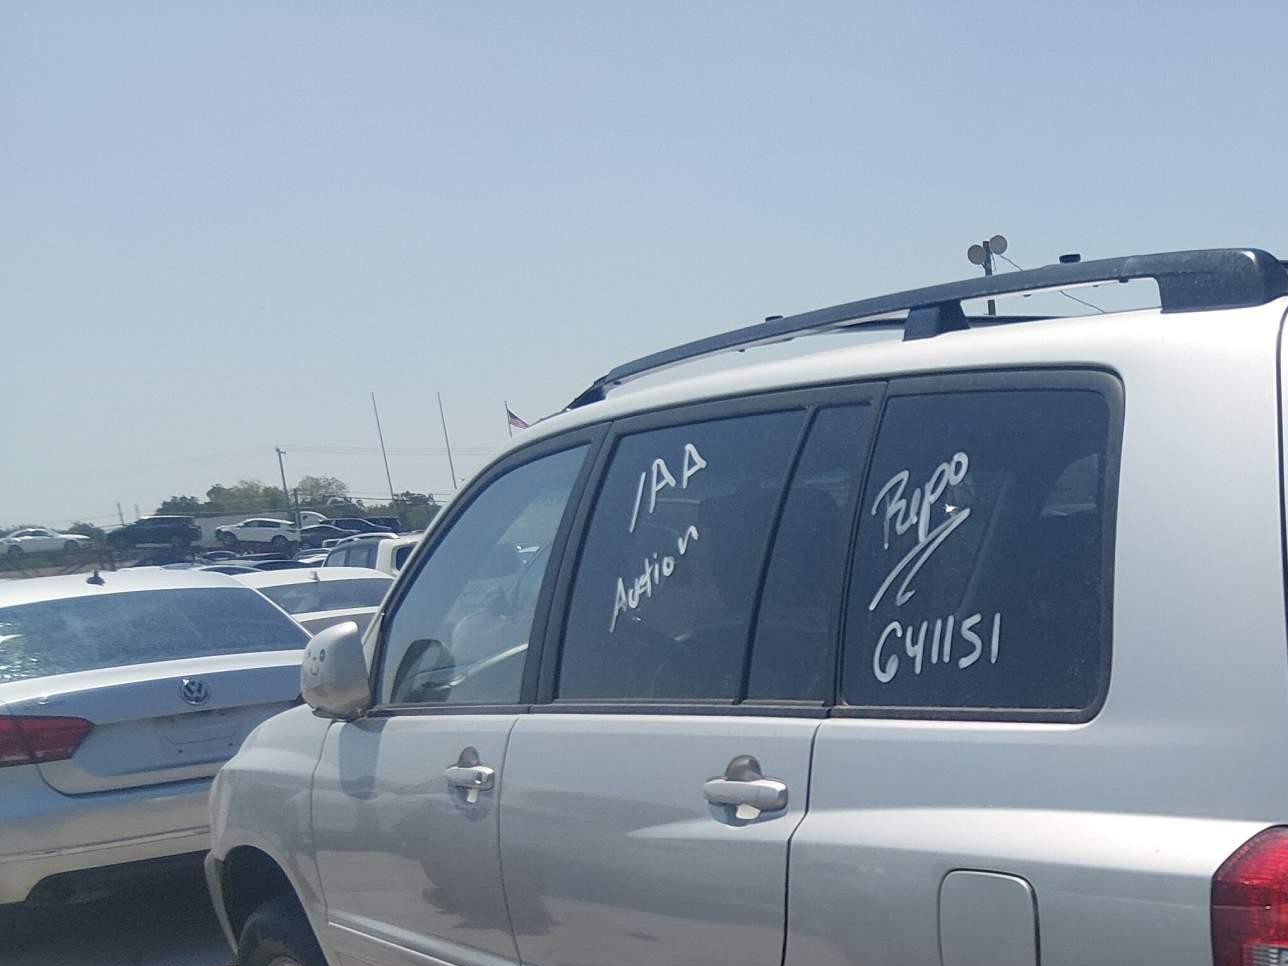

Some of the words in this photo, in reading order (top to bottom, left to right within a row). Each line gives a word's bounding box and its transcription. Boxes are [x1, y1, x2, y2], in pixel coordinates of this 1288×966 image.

[629, 443, 707, 533] IAA
[610, 525, 698, 632] Auction
[873, 612, 1000, 683] 641151
